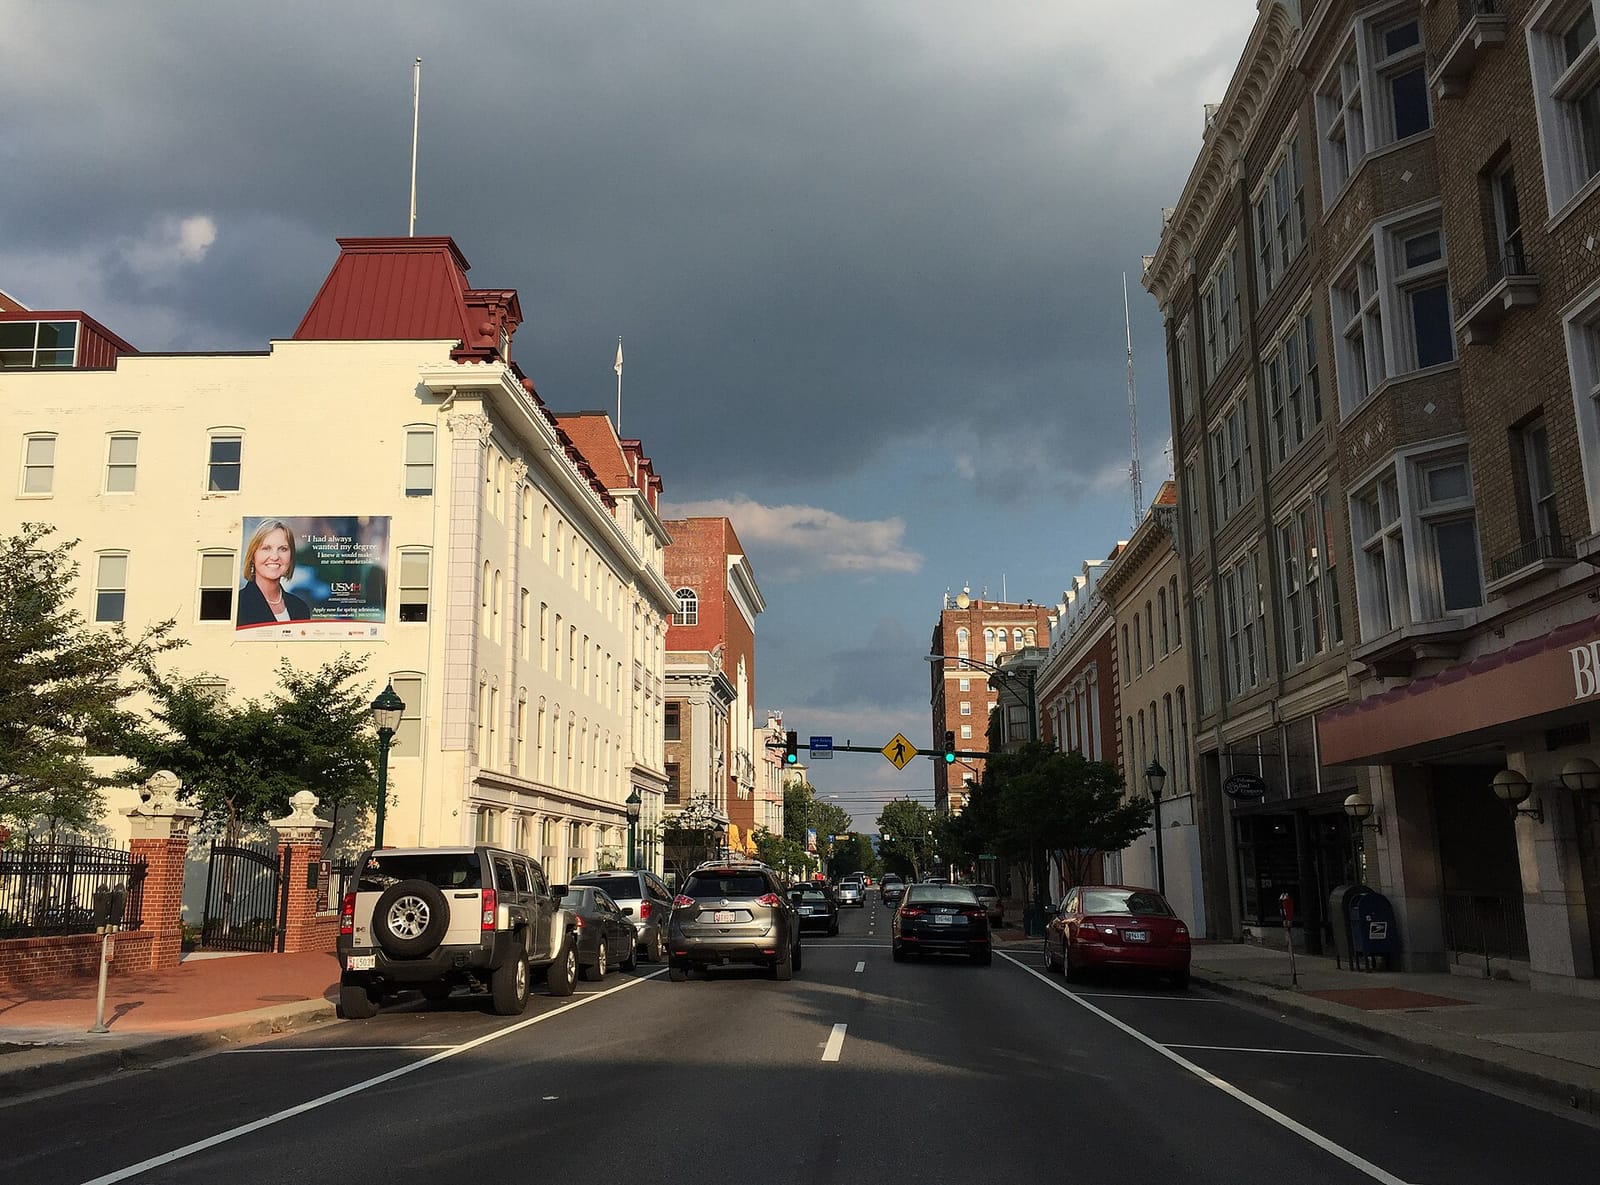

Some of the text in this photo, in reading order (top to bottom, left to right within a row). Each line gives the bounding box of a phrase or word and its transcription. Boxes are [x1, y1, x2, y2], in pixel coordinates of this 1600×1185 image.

[312, 535, 327, 543] had
[328, 535, 352, 544] always
[340, 544, 352, 552] my
